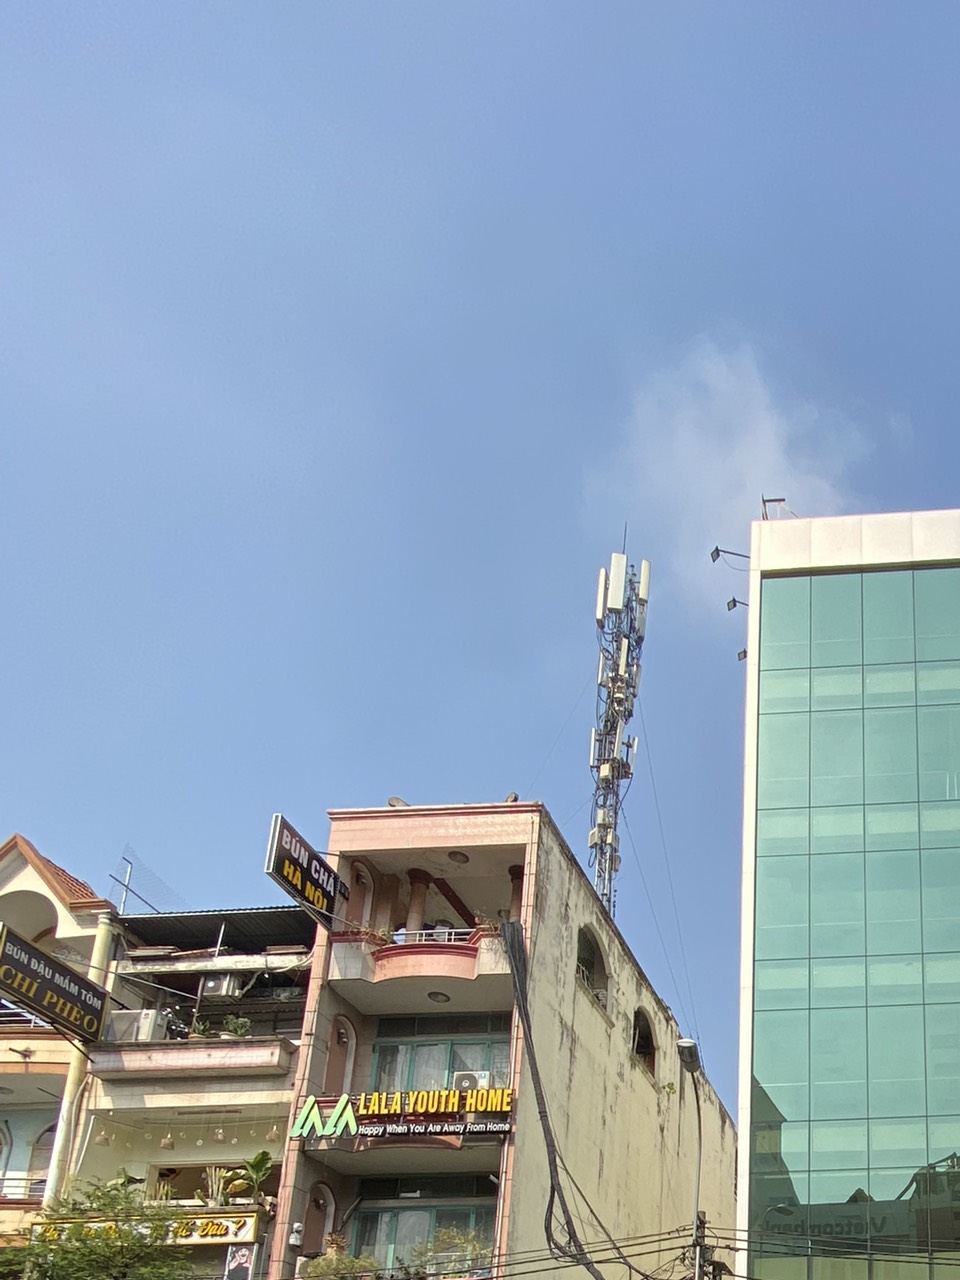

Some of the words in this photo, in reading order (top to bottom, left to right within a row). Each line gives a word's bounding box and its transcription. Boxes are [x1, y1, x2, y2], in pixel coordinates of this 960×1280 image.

[281, 828, 309, 868] BÚN
[282, 859, 302, 890] HÀ
[5, 941, 29, 965] BÚN
[30, 957, 53, 979] ĐẬU
[80, 988, 102, 1010] TÔM
[0, 964, 41, 999] CHÍ
[41, 990, 98, 1032] PHÈO
[358, 1091, 401, 1115] LALA
[406, 1089, 460, 1114] YOUTH
[465, 1088, 513, 1112] HOME
[358, 1125, 384, 1136] Happy
[386, 1124, 408, 1134] When
[409, 1123, 425, 1133] You
[427, 1123, 442, 1133] Are
[442, 1122, 464, 1134] Away
[466, 1122, 486, 1132] From
[486, 1121, 510, 1132] Home
